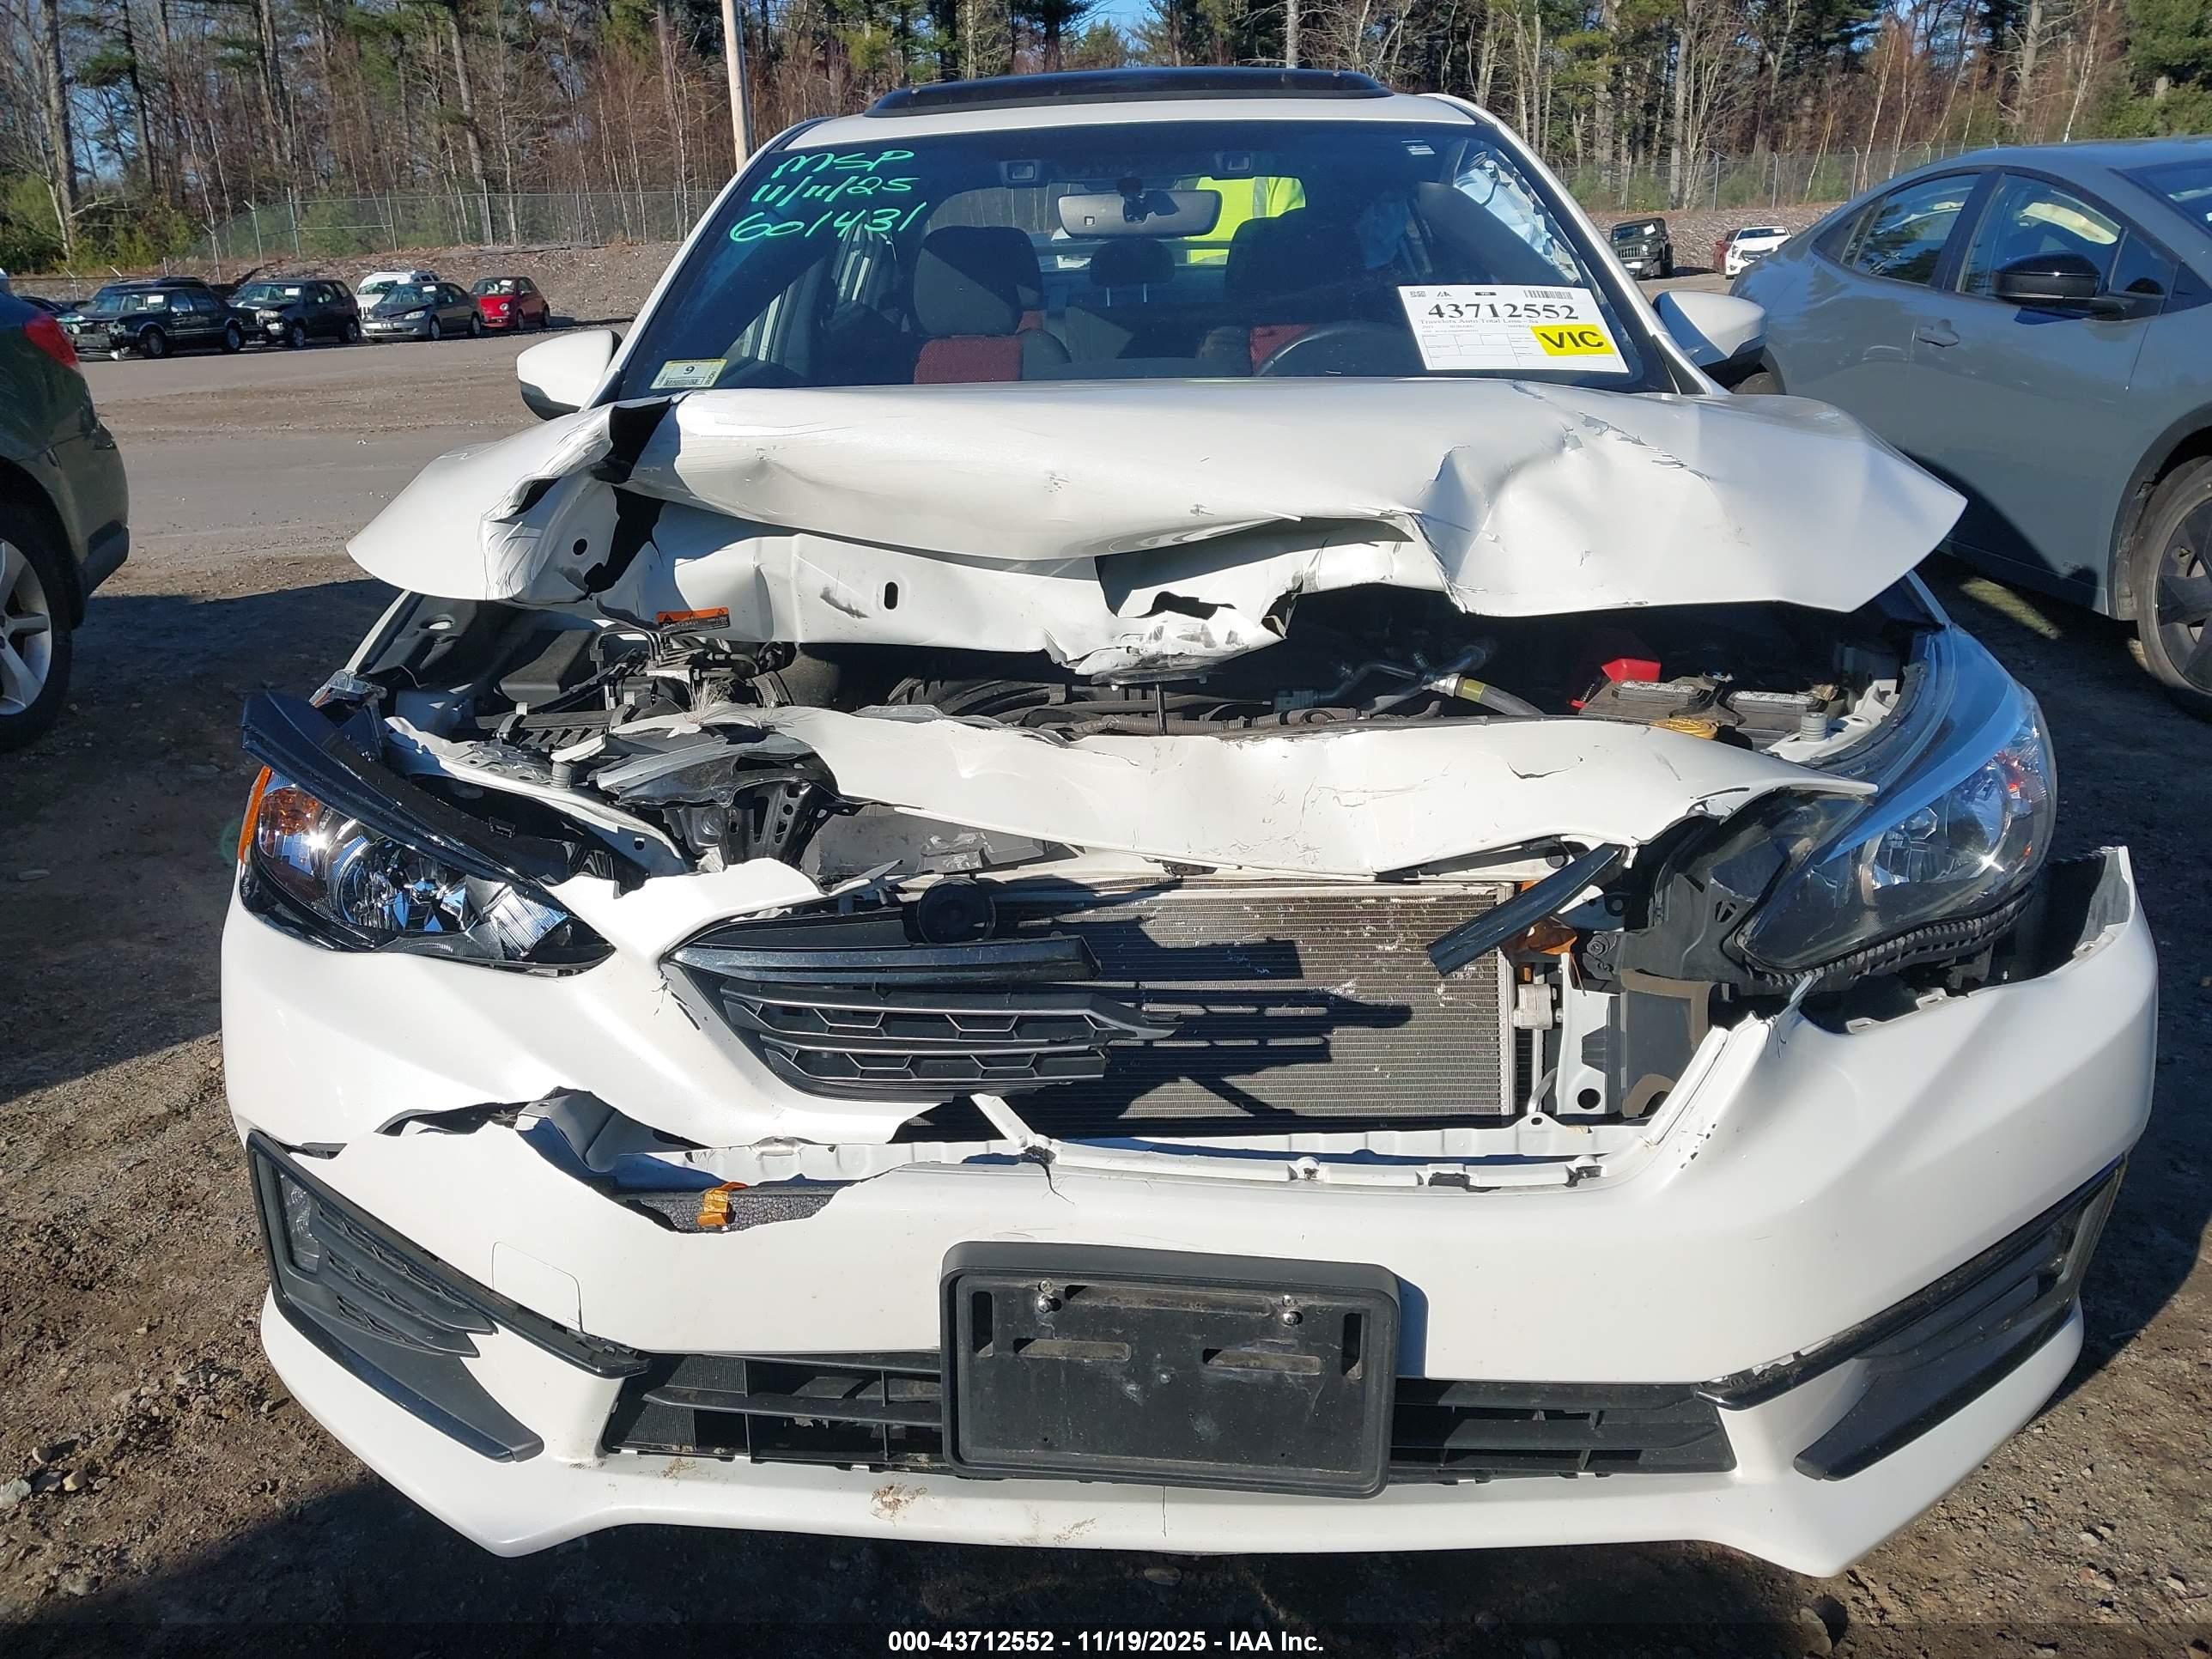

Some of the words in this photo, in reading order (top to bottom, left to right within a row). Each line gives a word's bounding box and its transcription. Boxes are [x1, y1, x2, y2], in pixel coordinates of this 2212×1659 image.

[771, 150, 915, 179] MSP
[750, 176, 921, 206] 11/11/25
[730, 202, 927, 242] 601431
[1428, 303, 1579, 320] 43712552
[1540, 331, 1604, 349] VIC
[684, 366, 696, 374] 9
